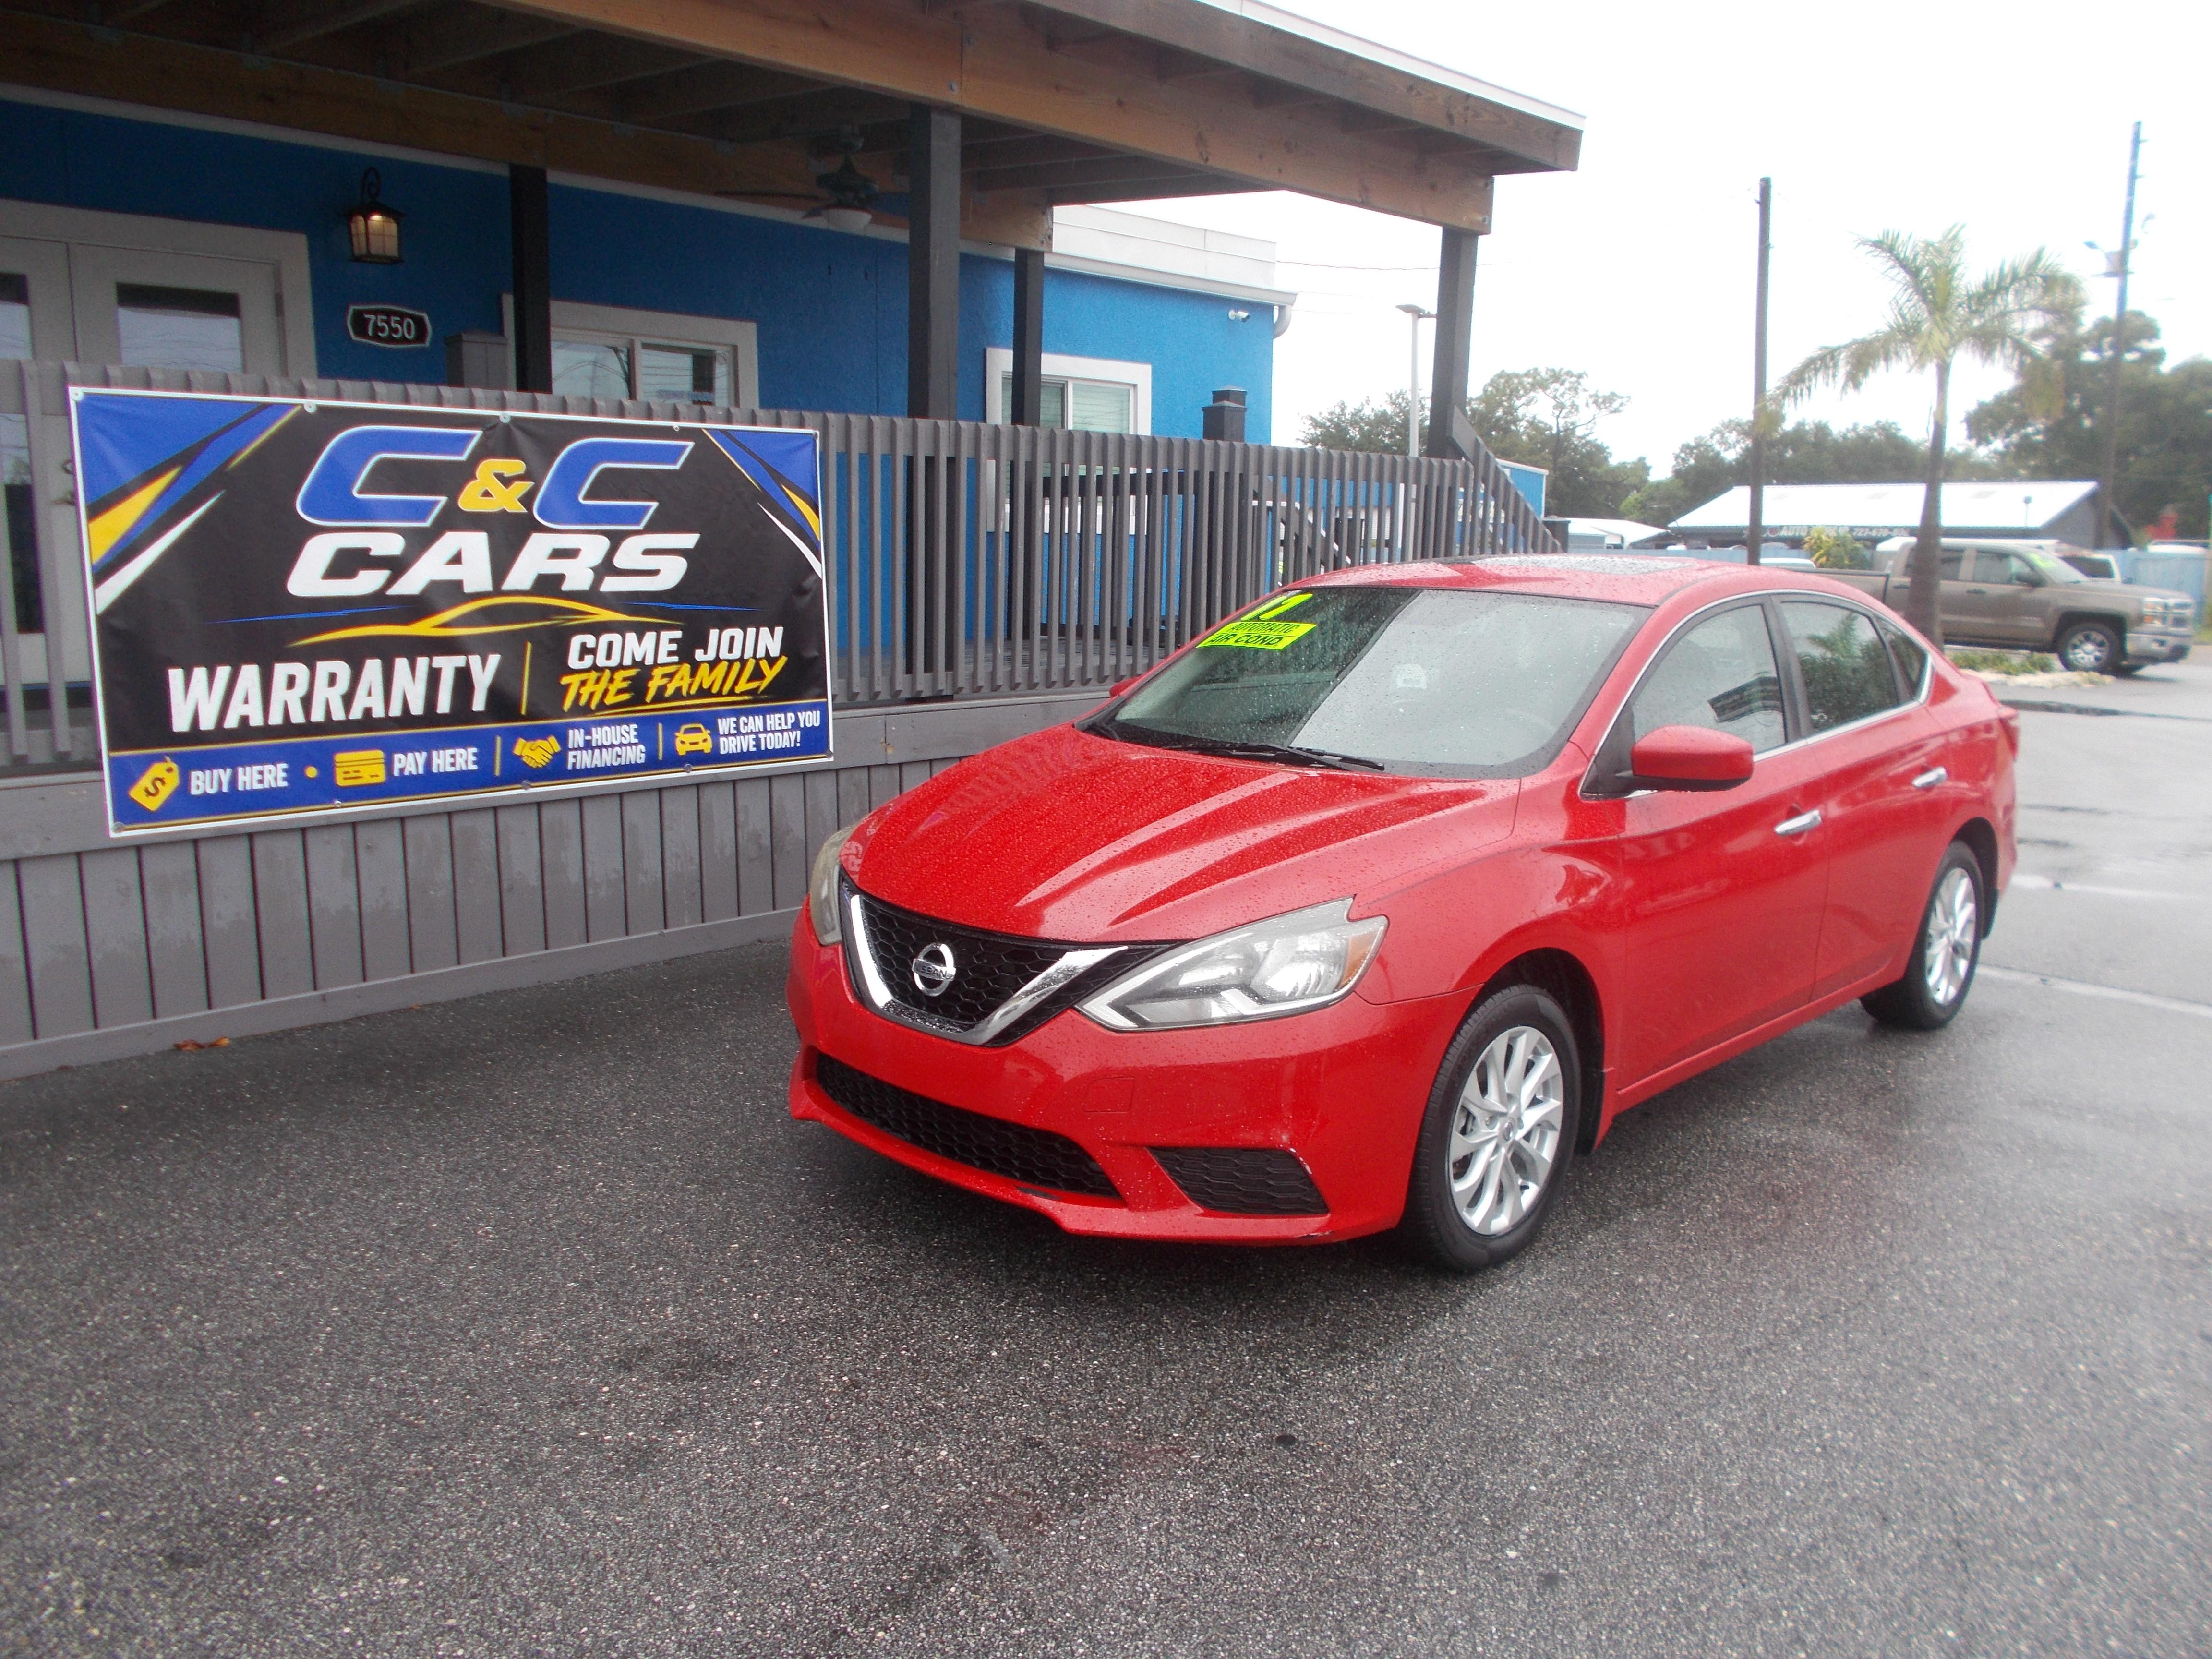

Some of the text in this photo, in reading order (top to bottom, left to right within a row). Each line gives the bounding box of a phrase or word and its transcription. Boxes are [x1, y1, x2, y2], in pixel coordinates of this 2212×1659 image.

[364, 314, 415, 339] 7550
[296, 425, 695, 529] C&C
[287, 532, 700, 597] CARS
[1209, 634, 1238, 643] AIR
[1227, 623, 1300, 634] AUTOMATIC
[567, 626, 783, 669] COME JOIN
[168, 654, 502, 733] WARRANTY
[560, 656, 788, 712] THE FAMILY
[718, 710, 821, 735] WE CAN HELP YOU
[568, 724, 638, 749] IN-HOUSE
[720, 731, 801, 755] DRIVE TODAY!
[393, 747, 478, 777] PAY HERE
[567, 745, 646, 770] FINANCING
[191, 763, 289, 795] BUY HERE
